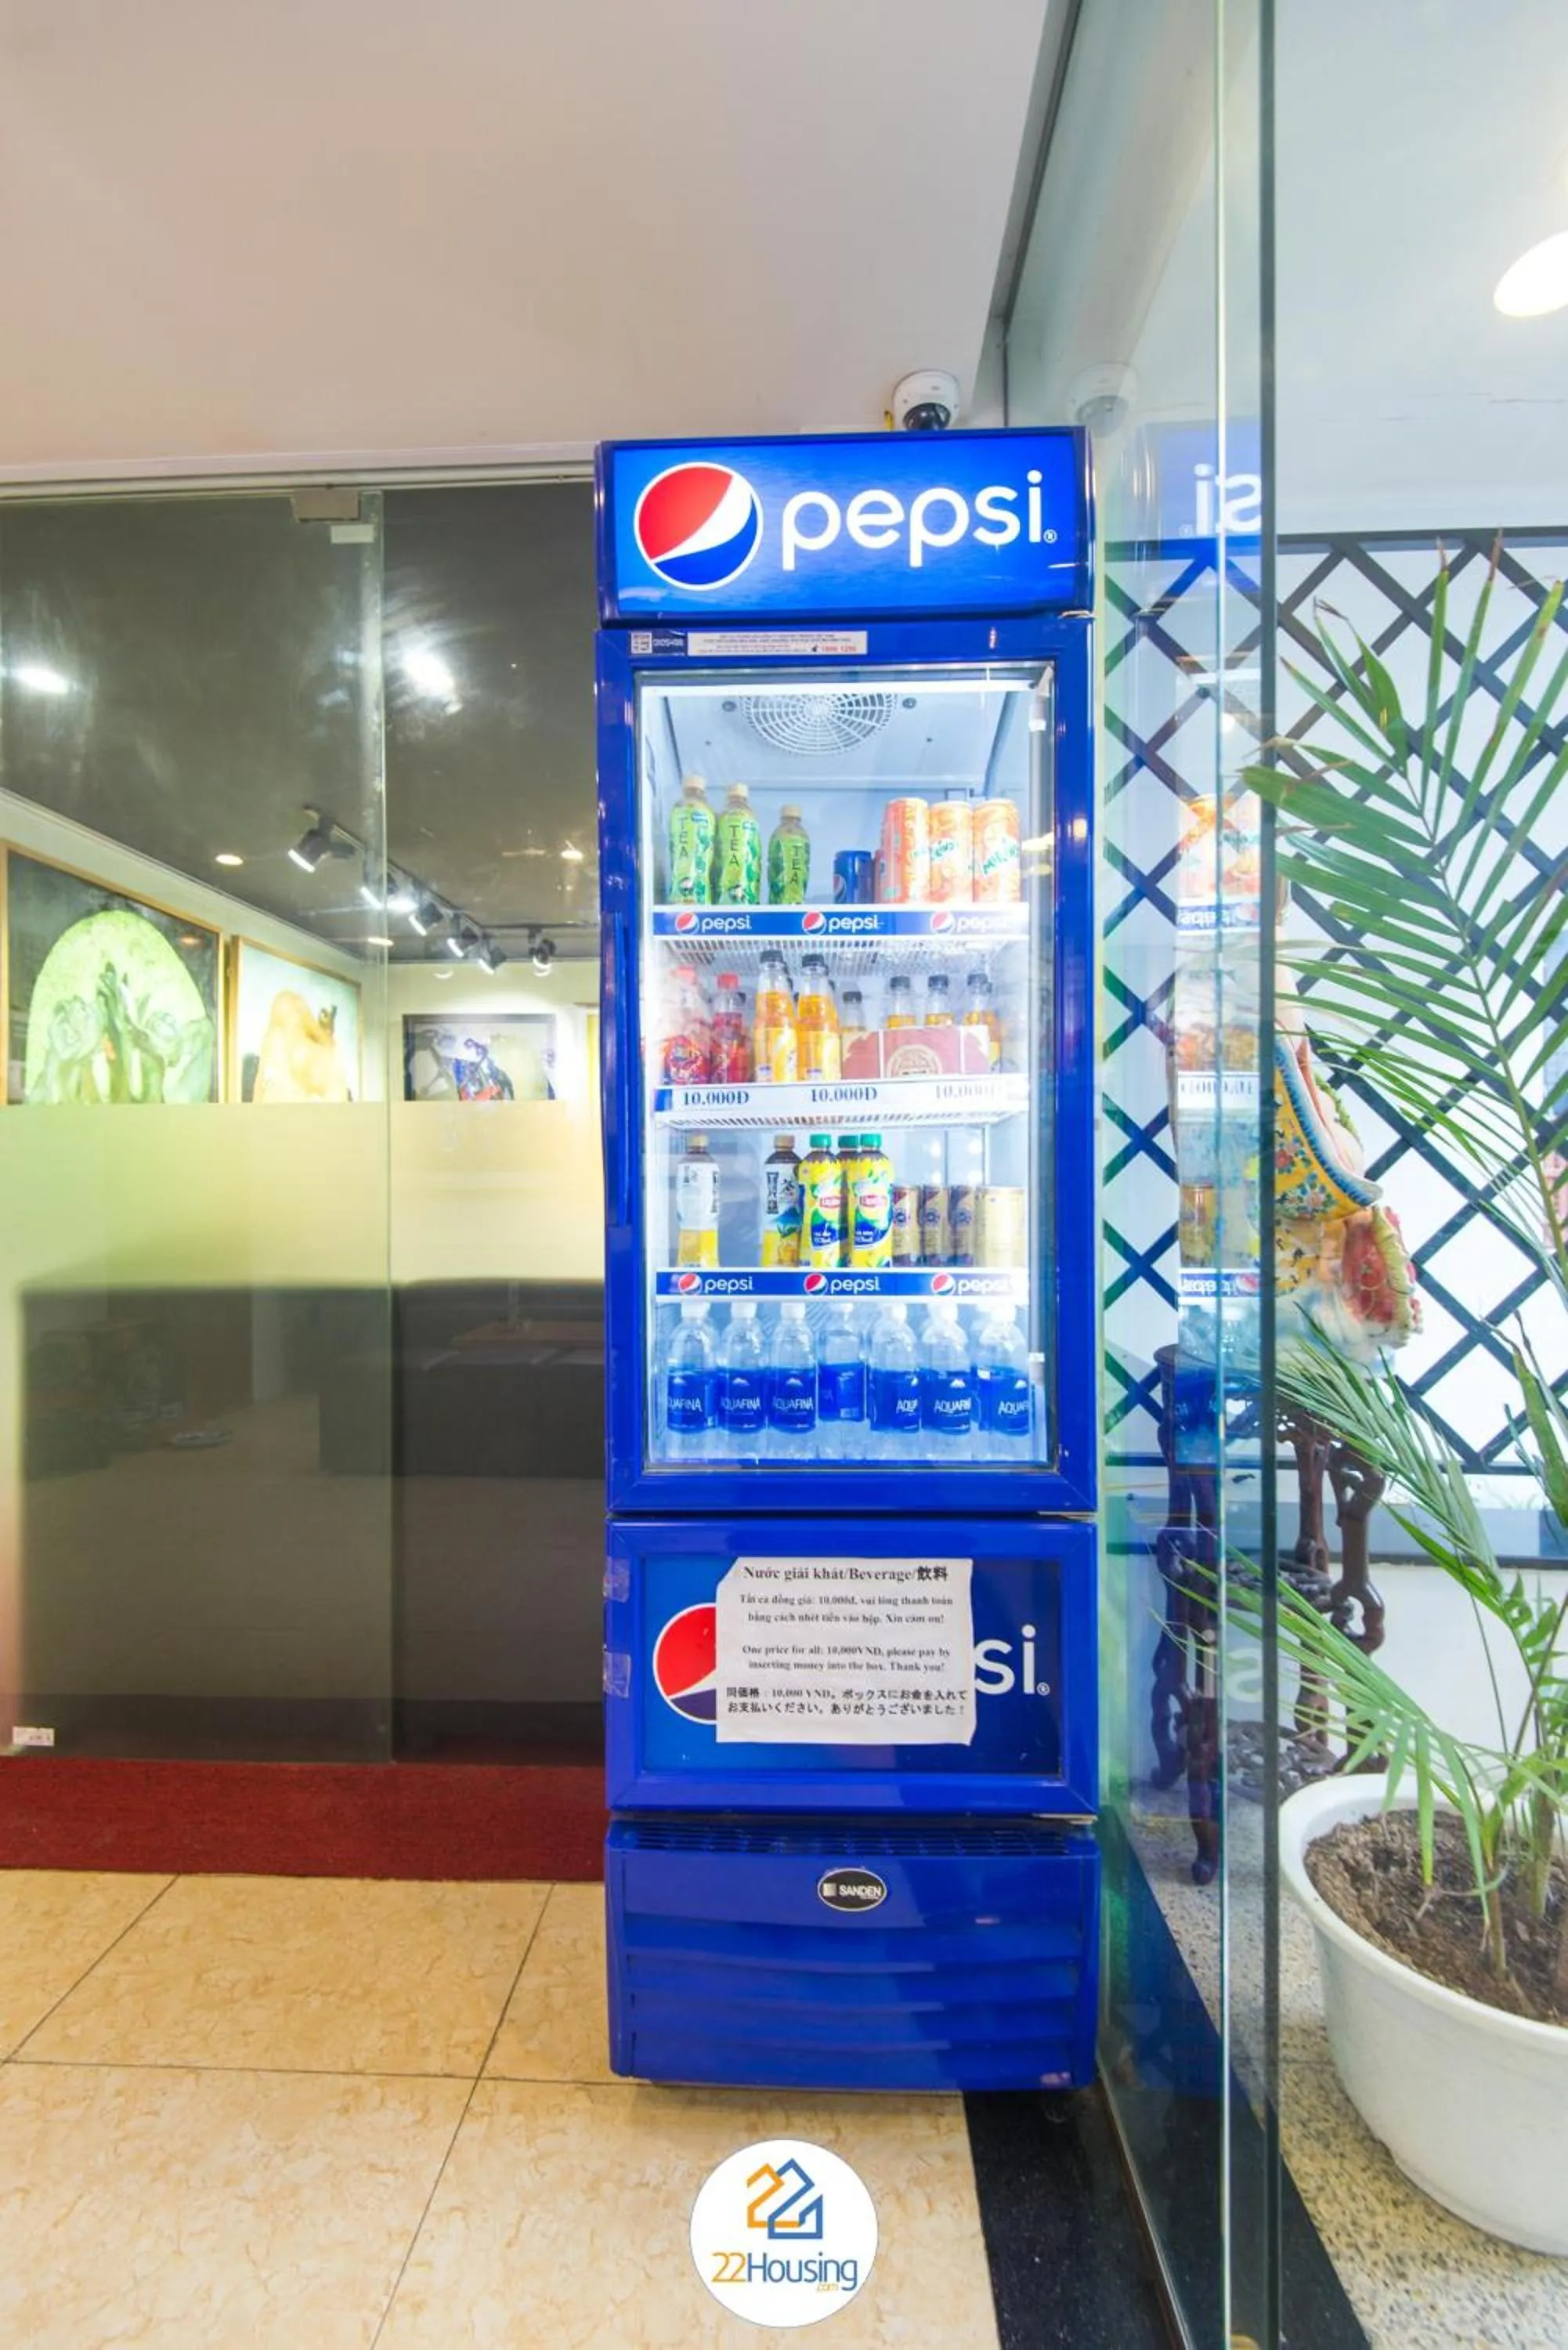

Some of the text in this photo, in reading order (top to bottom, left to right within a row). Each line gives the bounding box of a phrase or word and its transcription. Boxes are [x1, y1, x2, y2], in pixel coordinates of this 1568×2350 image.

[782, 469, 1042, 570] pepsi
[677, 818, 689, 858] TEA
[728, 825, 740, 867] TEA
[789, 845, 802, 884] TEA
[701, 915, 752, 933] pepsi
[828, 915, 879, 932] pepsi
[704, 1276, 753, 1294] pepsi
[830, 1277, 880, 1294] pepsi
[742, 1646, 762, 1655] One
[764, 1646, 789, 1657] price
[792, 1646, 804, 1654] for
[887, 1647, 916, 1658] please
[919, 1649, 934, 1658] pay
[938, 1647, 951, 1658] by
[749, 1660, 790, 1671] inserting
[793, 1661, 823, 1671] money
[827, 1661, 846, 1670] into
[848, 1661, 862, 1671] the
[890, 1661, 921, 1672] Thank
[839, 1884, 882, 1896] SANDEN
